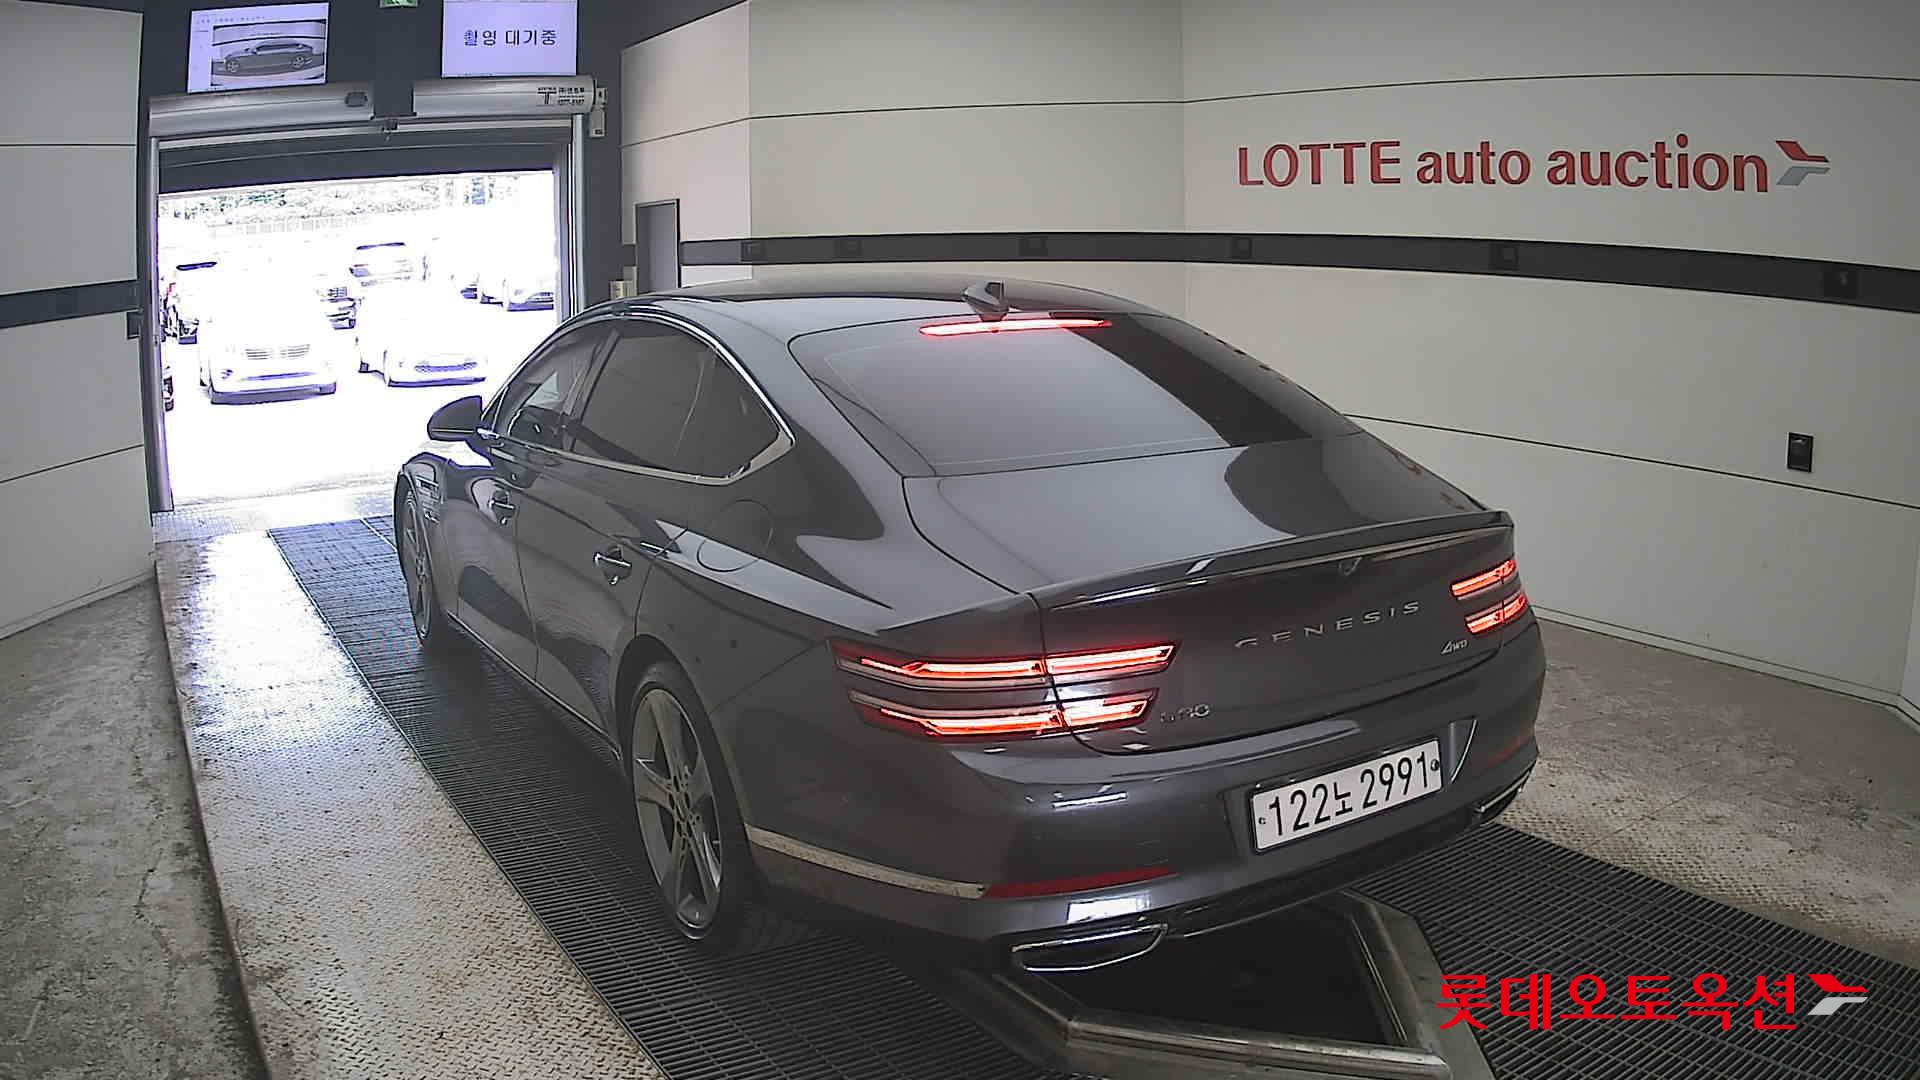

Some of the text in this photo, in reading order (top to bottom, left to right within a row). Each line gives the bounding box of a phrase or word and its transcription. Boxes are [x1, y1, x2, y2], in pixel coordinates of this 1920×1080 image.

[505, 29, 557, 46] 대기중
[1238, 133, 1768, 192] LOTTE auto auction
[1160, 703, 1210, 723] 80
[1269, 751, 1428, 837] 122노 2991
